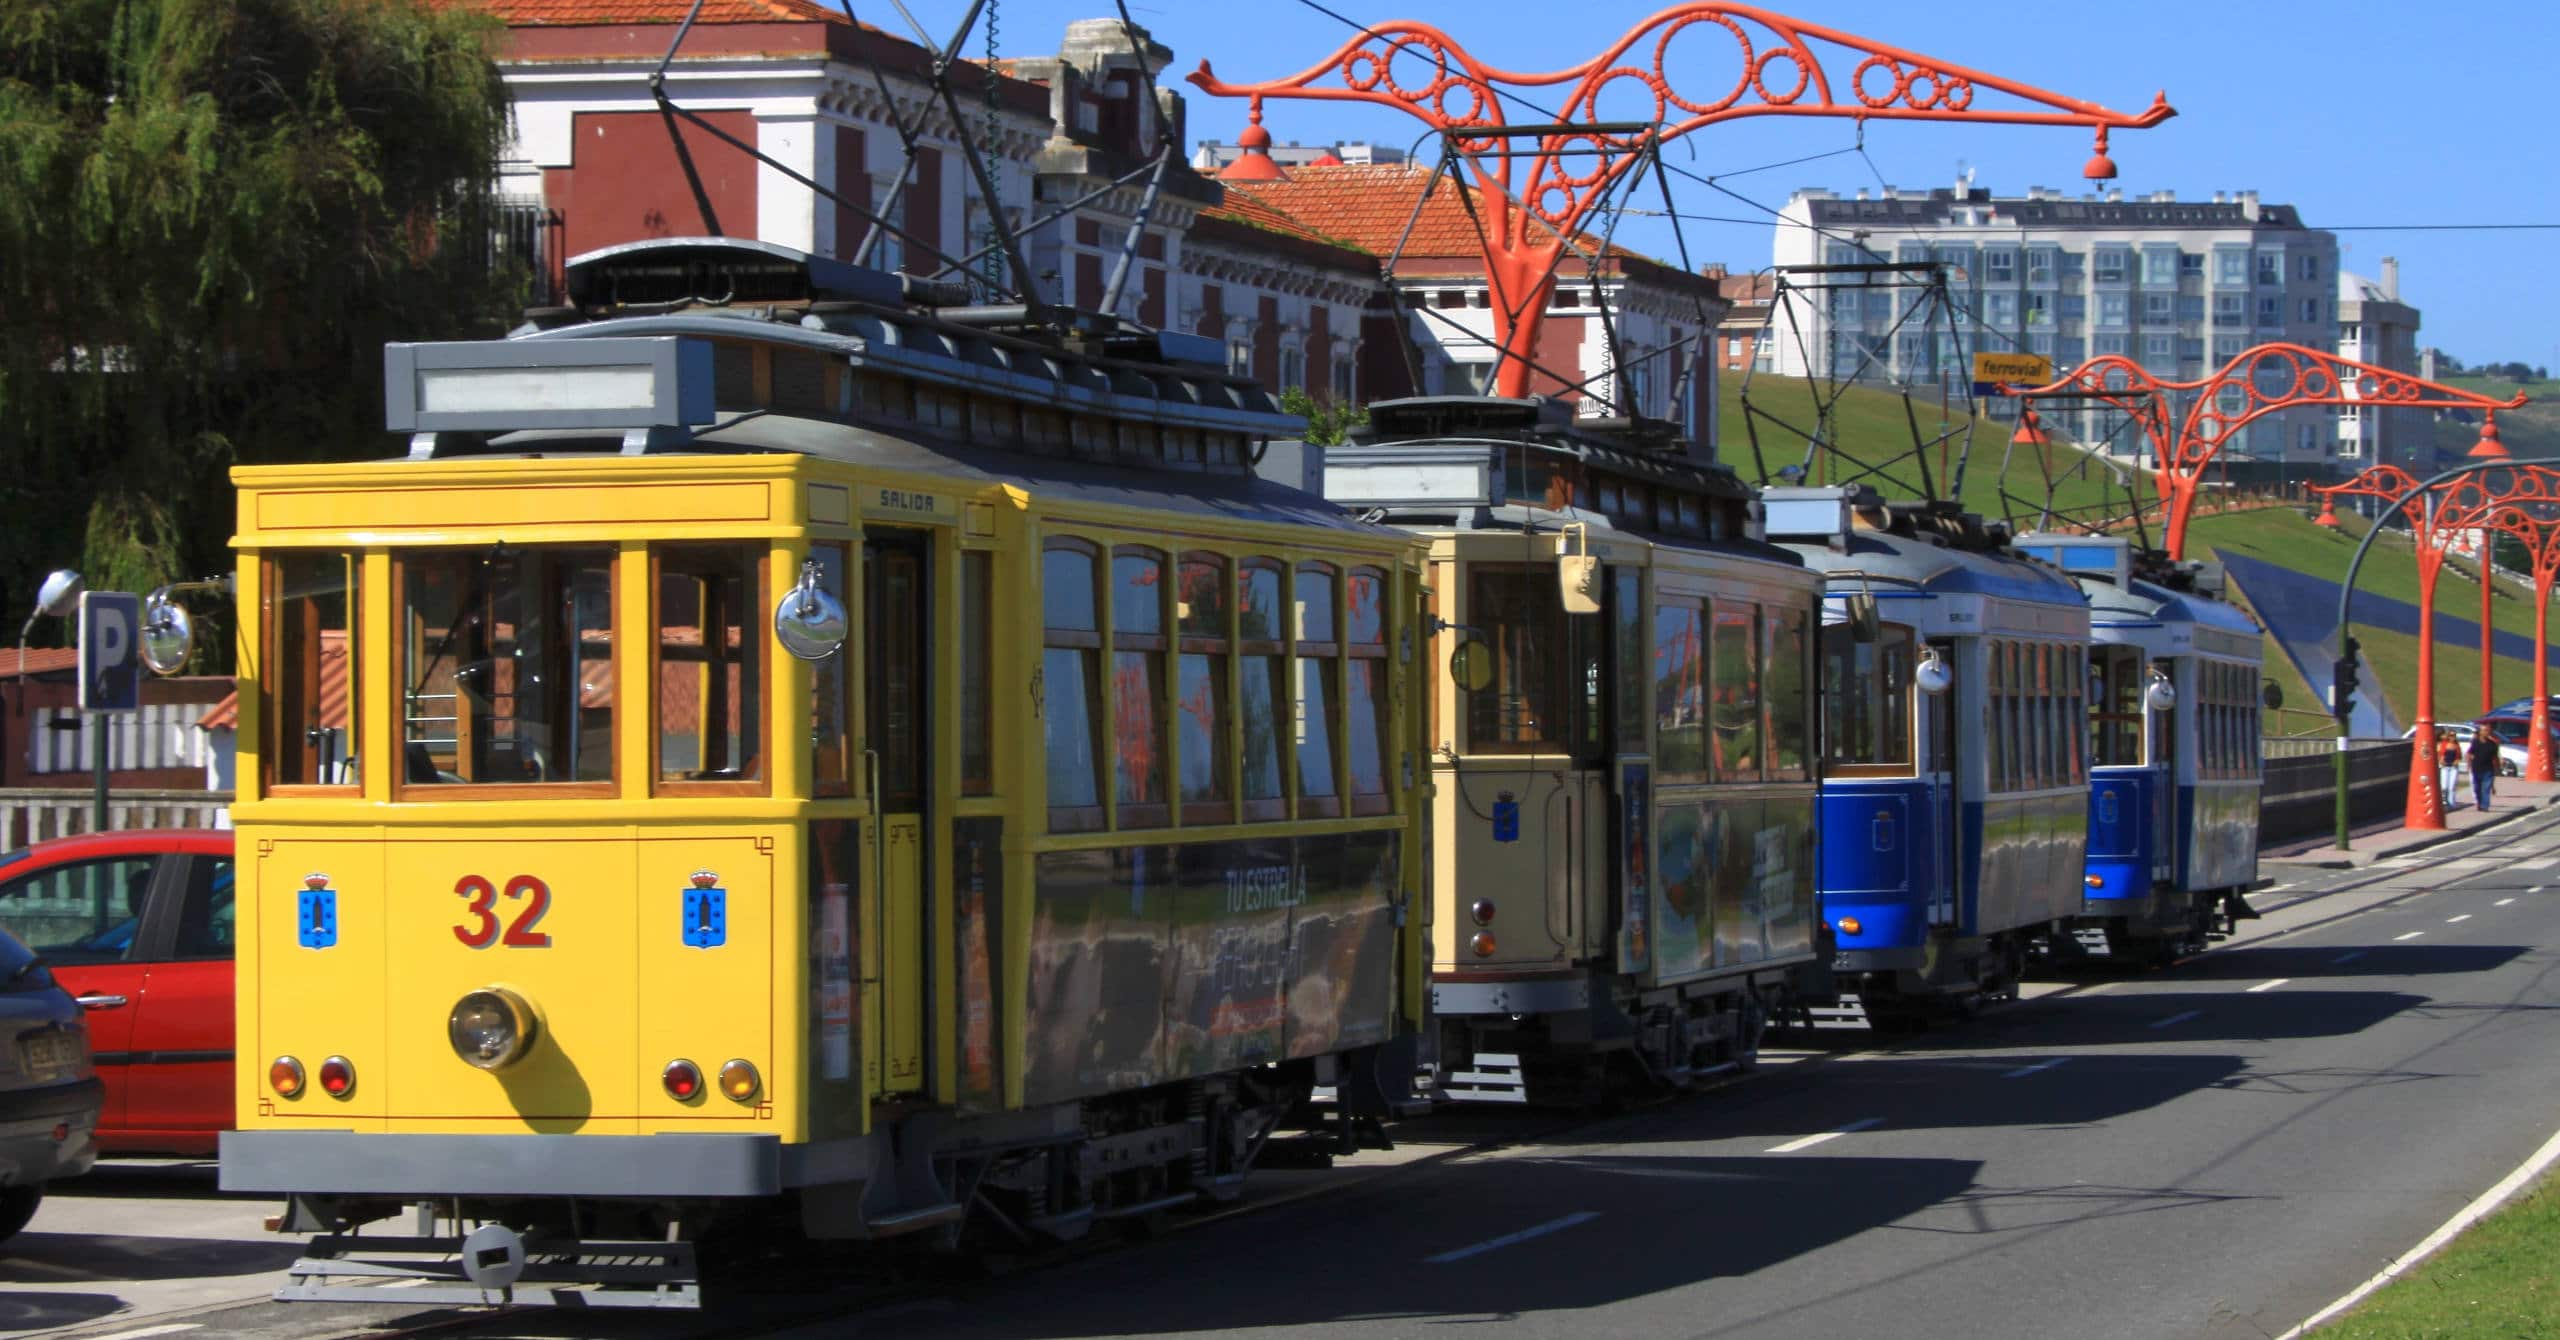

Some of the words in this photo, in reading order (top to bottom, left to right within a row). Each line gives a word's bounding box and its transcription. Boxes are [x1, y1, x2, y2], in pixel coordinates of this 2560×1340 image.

[1983, 360, 2043, 377] ferrovial
[880, 489, 934, 513] SALIDA
[96, 608, 128, 698] P
[453, 875, 552, 950] 32
[1225, 870, 1243, 913] TU
[1246, 864, 1307, 913] ESTRELLA
